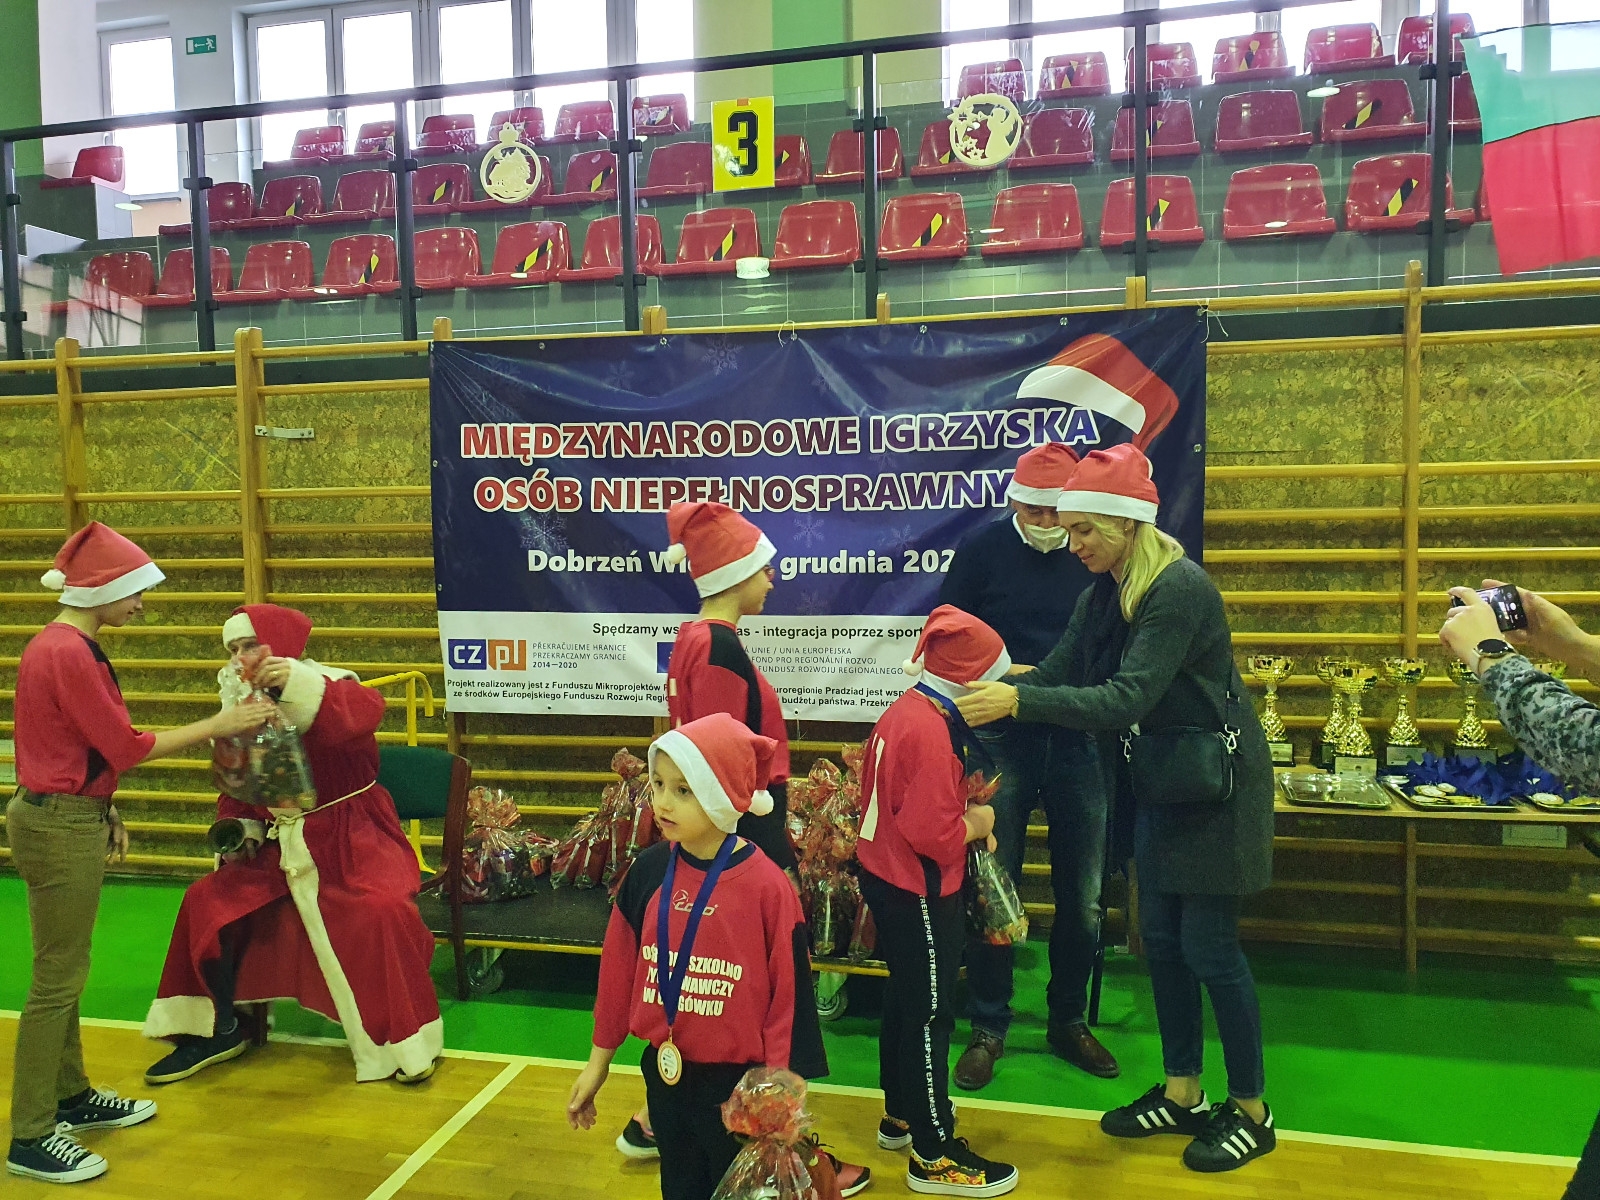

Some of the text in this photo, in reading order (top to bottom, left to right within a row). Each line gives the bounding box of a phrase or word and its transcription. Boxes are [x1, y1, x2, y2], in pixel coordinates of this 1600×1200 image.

[728, 110, 757, 177] 3
[461, 407, 1100, 466] MIĘDZYNARODOWE IGRZYSKA
[474, 469, 1016, 513] OSÓB NIEPEŁNOSPRAWNY
[528, 549, 642, 574] Dobrzeń
[779, 549, 893, 580] grudnia
[903, 549, 956, 573] 202
[592, 623, 658, 637] Spędzamy
[737, 627, 751, 636] as
[763, 626, 827, 640] integracja
[831, 627, 884, 640] poprzez
[532, 642, 627, 652] PŘEKRAČUJEME HRANICE
[802, 647, 852, 655] EUROPEJSKA
[532, 652, 627, 661] PRZEKRACZAMY GRANICE
[751, 655, 877, 665] FOND PRO REGIONÁLNÍ ROZVOJ
[798, 665, 836, 674] ROZWOJU
[838, 666, 904, 675] REGIONALNEGO
[447, 679, 475, 691] Projekt
[477, 680, 526, 690] realizowany
[528, 681, 543, 690] jest
[552, 681, 594, 690] Funduszu
[595, 682, 661, 692] Mikroprojektów
[774, 685, 823, 695] uroregionie
[825, 687, 864, 695] Pradziad
[866, 688, 883, 697] jest
[464, 689, 500, 698] środków
[502, 690, 561, 700] Europejskiego
[563, 691, 605, 700] Funduszu
[607, 692, 644, 702] Rozwoju
[818, 697, 858, 707] państwa.
[688, 955, 743, 981] SZKOLNO
[642, 986, 656, 1004] W
